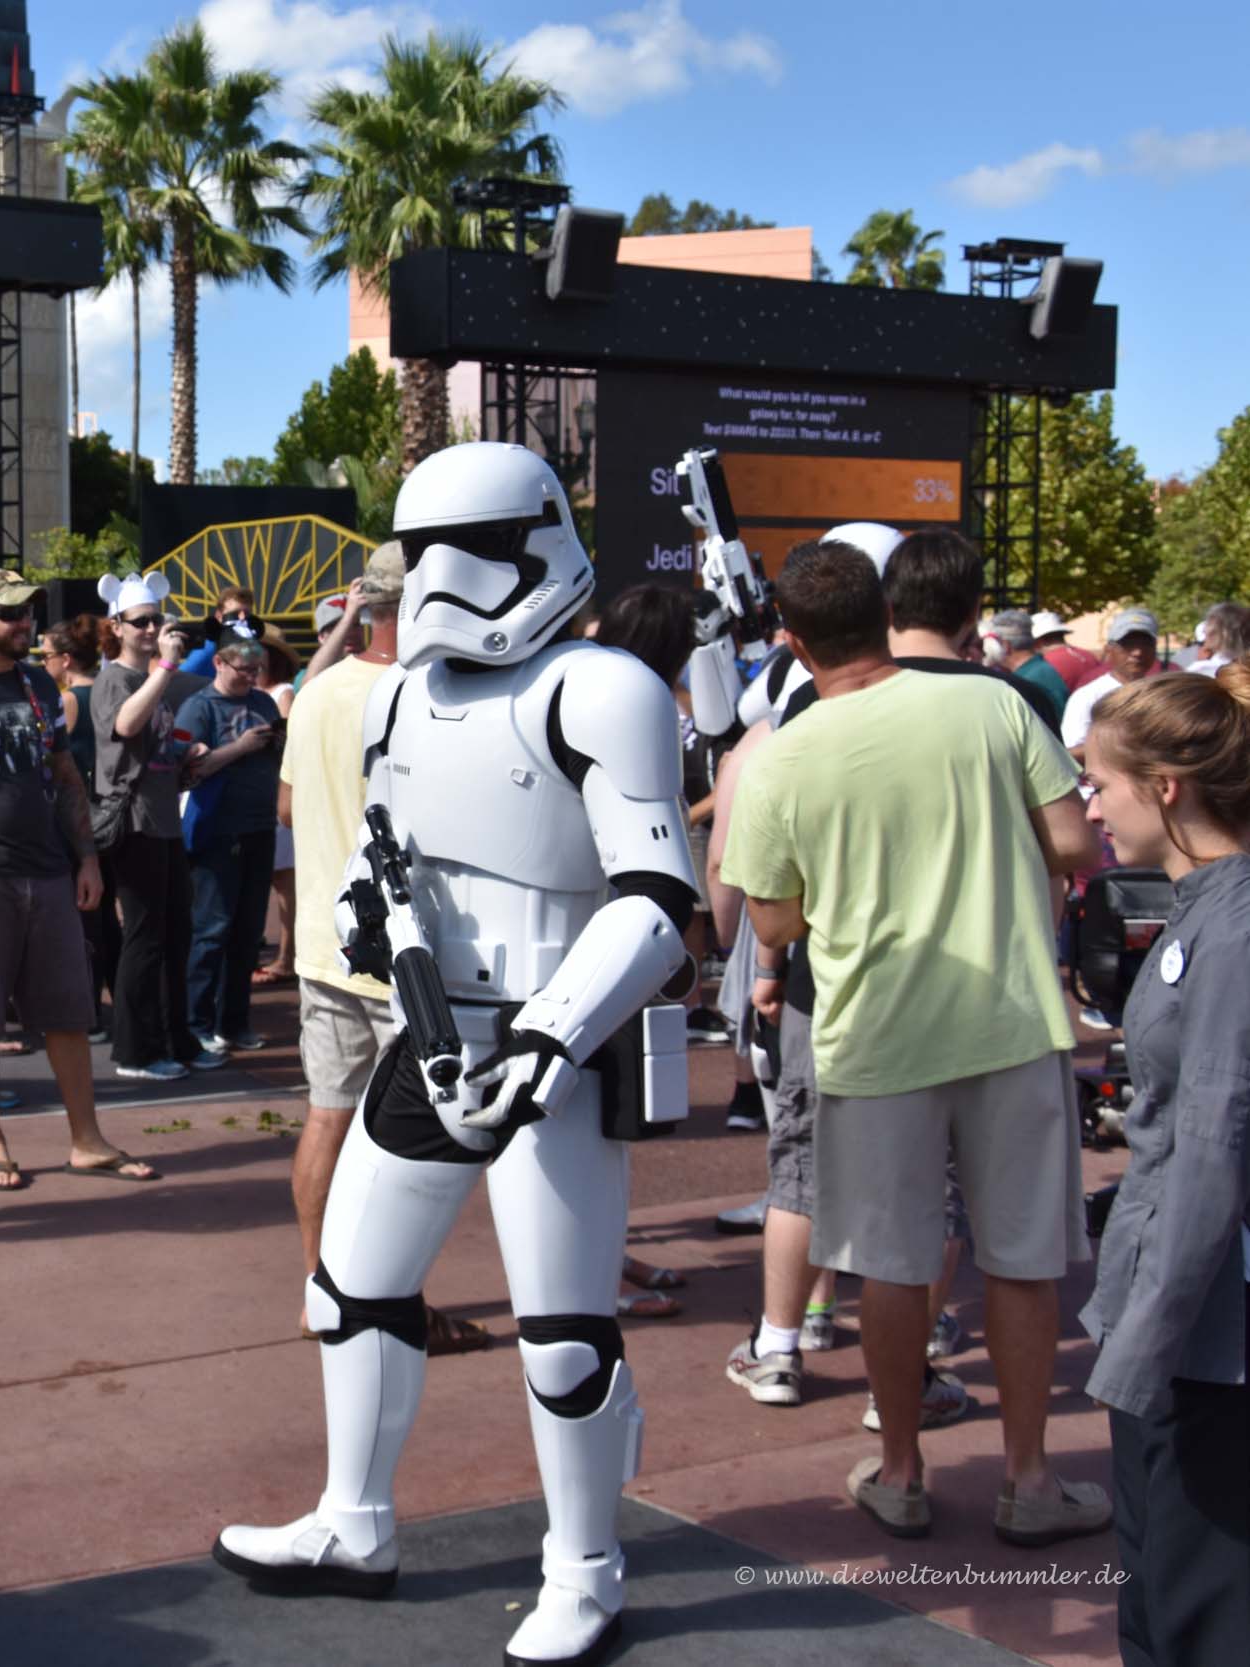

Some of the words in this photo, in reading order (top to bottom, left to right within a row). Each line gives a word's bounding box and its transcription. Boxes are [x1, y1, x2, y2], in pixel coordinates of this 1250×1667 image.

[718, 387, 742, 399] What
[743, 389, 771, 401] would
[772, 391, 789, 403] you
[790, 391, 801, 403] be
[811, 394, 827, 406] you
[749, 408, 778, 421] galaxy
[703, 422, 723, 436] Text
[799, 427, 821, 440] Then
[913, 478, 956, 503] 33%
[646, 543, 693, 571] Jedi
